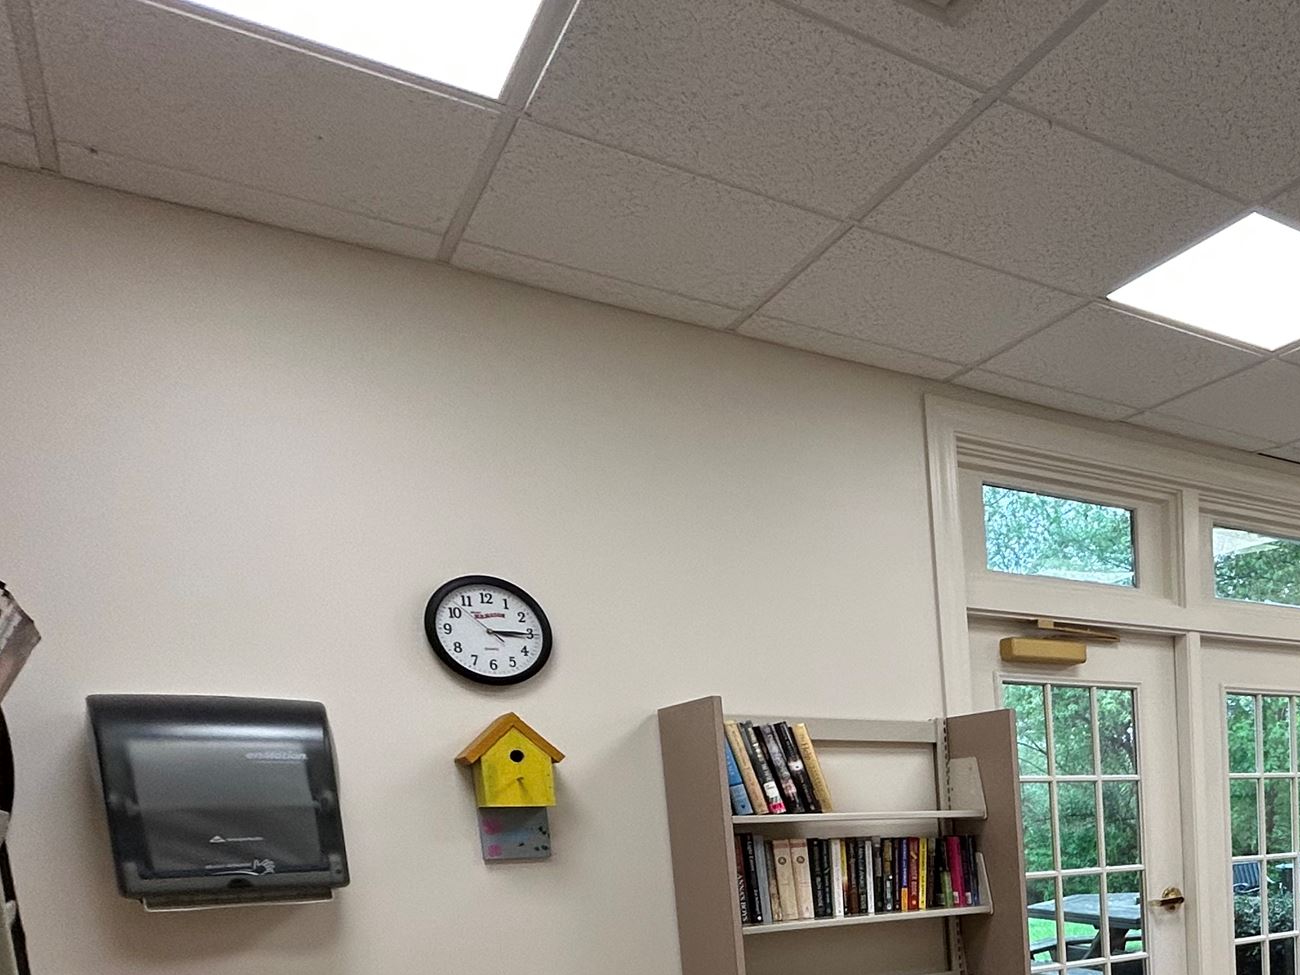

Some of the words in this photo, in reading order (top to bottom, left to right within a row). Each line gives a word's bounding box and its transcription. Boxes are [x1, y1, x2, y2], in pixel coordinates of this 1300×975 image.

[461, 595, 472, 606] 11
[480, 593, 493, 604] 12
[502, 599, 509, 609] 1
[448, 607, 462, 618] 10
[518, 612, 525, 622] 2
[443, 623, 452, 634] 9
[526, 628, 534, 639] 3
[454, 642, 462, 653] 8
[521, 646, 529, 656] 4
[471, 655, 478, 665] 7
[490, 659, 498, 670] 6
[509, 657, 516, 667] 5
